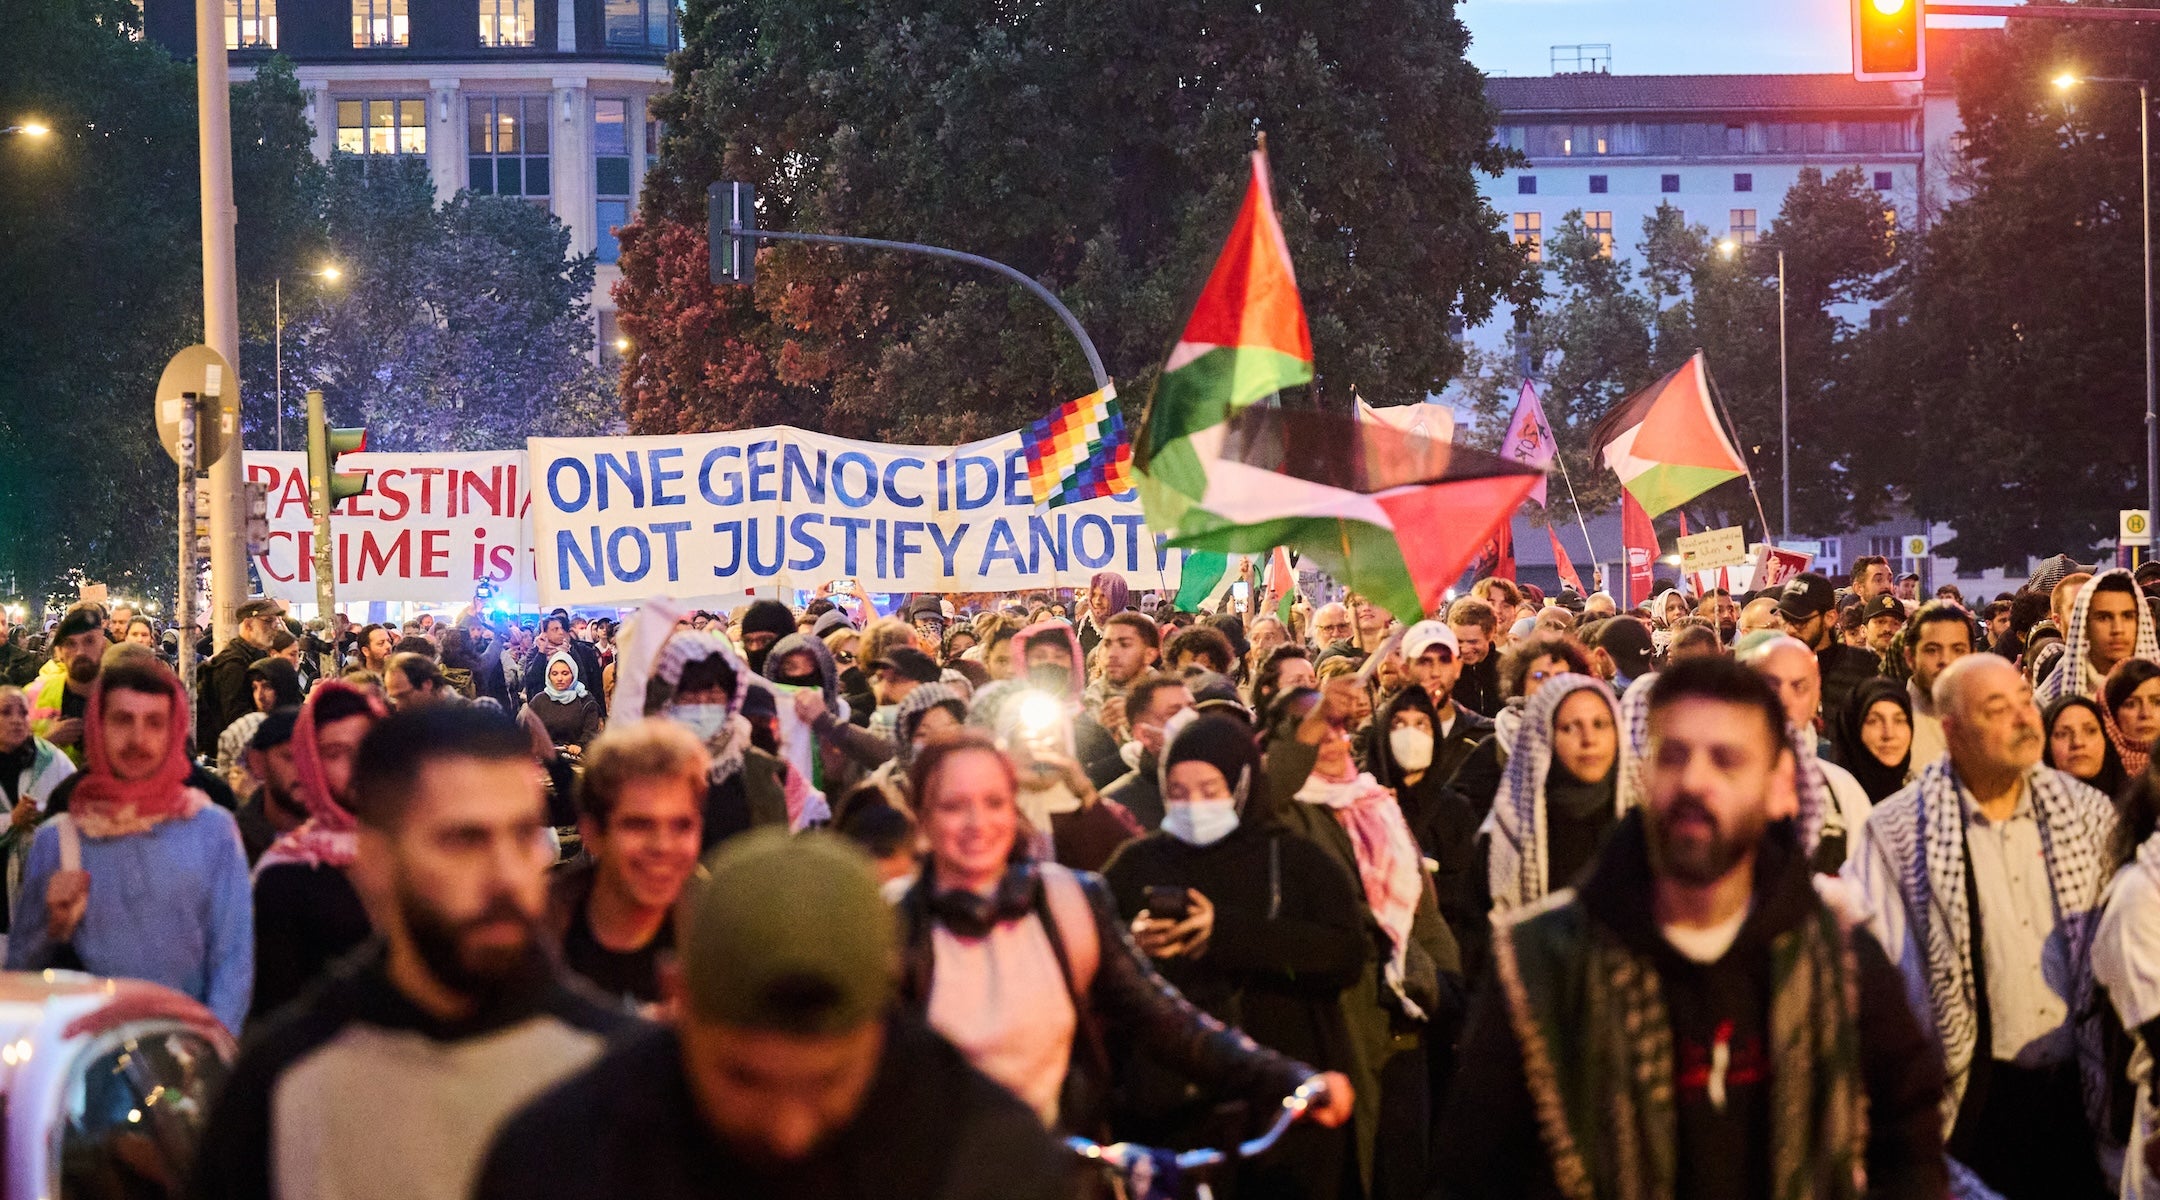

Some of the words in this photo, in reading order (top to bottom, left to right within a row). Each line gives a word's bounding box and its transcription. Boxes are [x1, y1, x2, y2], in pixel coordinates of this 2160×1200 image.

[248, 464, 531, 522] PAESTINI
[547, 447, 685, 513] ONE
[698, 440, 1034, 511] GENOCIDE
[473, 527, 515, 582] is
[556, 521, 692, 590] NOT
[713, 512, 970, 580] JUSTIFY
